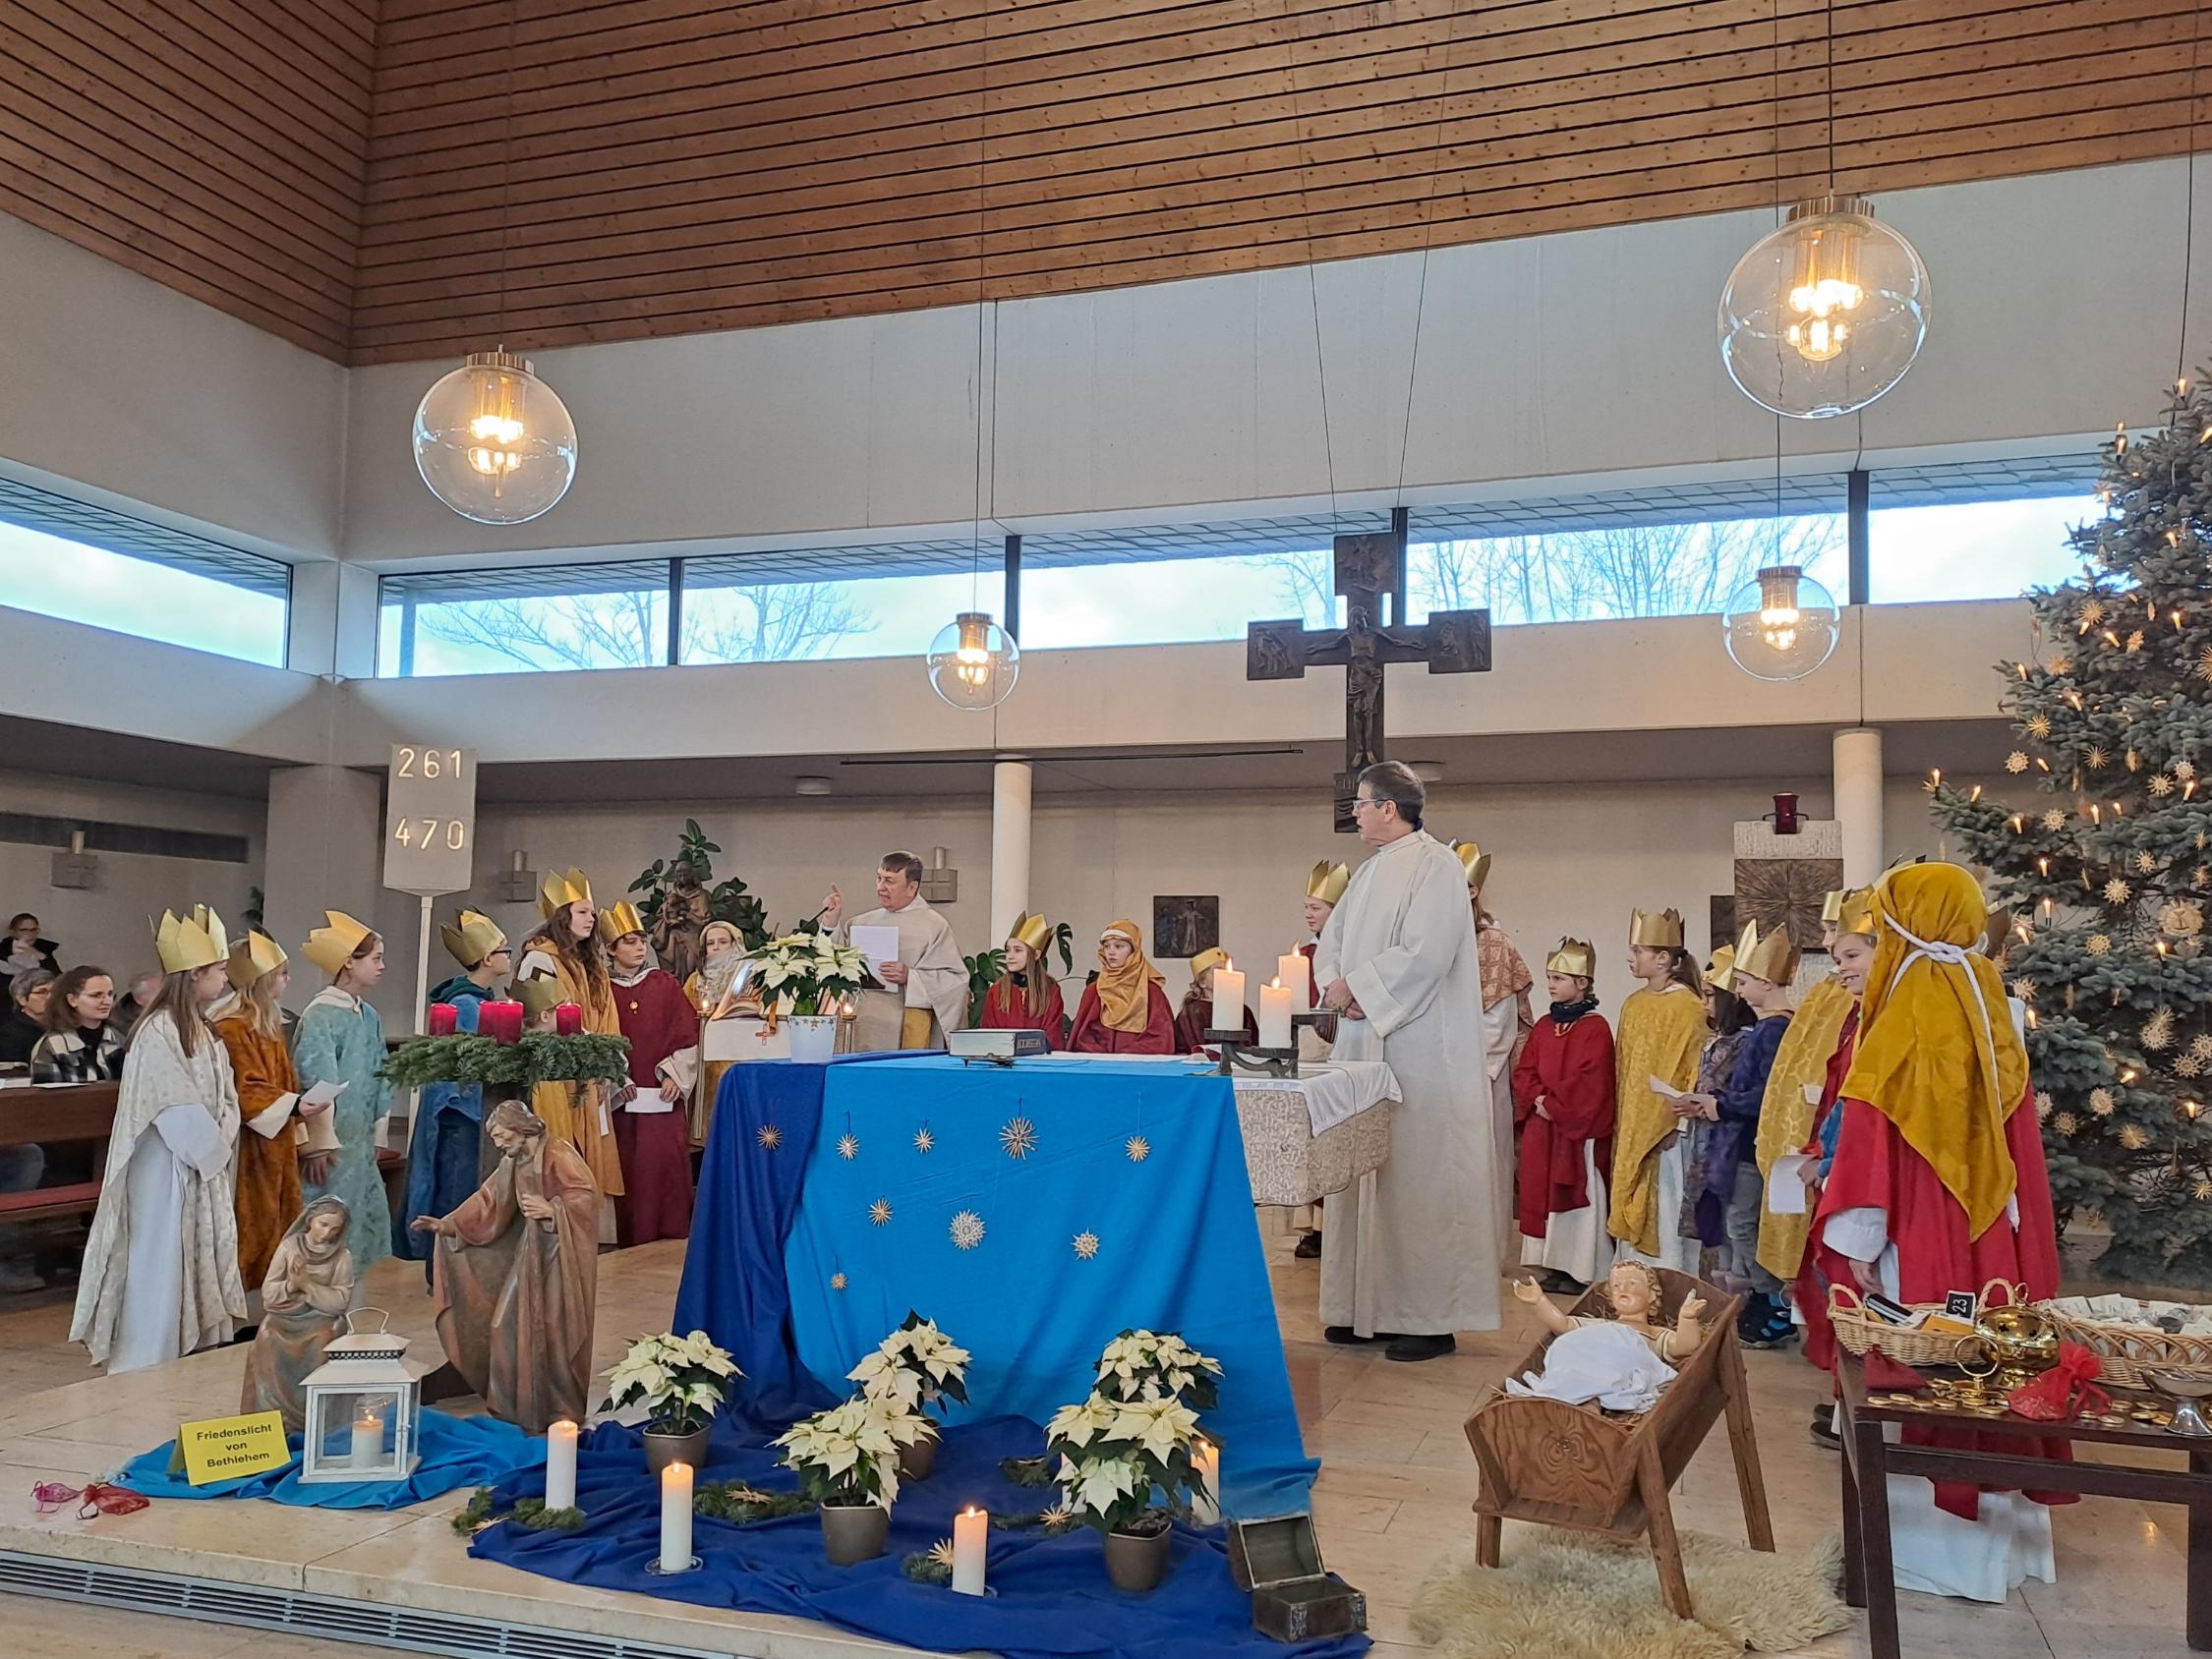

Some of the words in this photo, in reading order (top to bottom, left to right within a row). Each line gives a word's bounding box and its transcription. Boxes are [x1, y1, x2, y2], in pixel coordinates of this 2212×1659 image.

[398, 747, 461, 778] 261
[394, 818, 464, 850] 470
[1952, 1298, 1967, 1313] 23
[197, 1424, 272, 1441] Friedenslicht
[225, 1442, 247, 1451] von
[206, 1453, 269, 1467] Bethlehem
